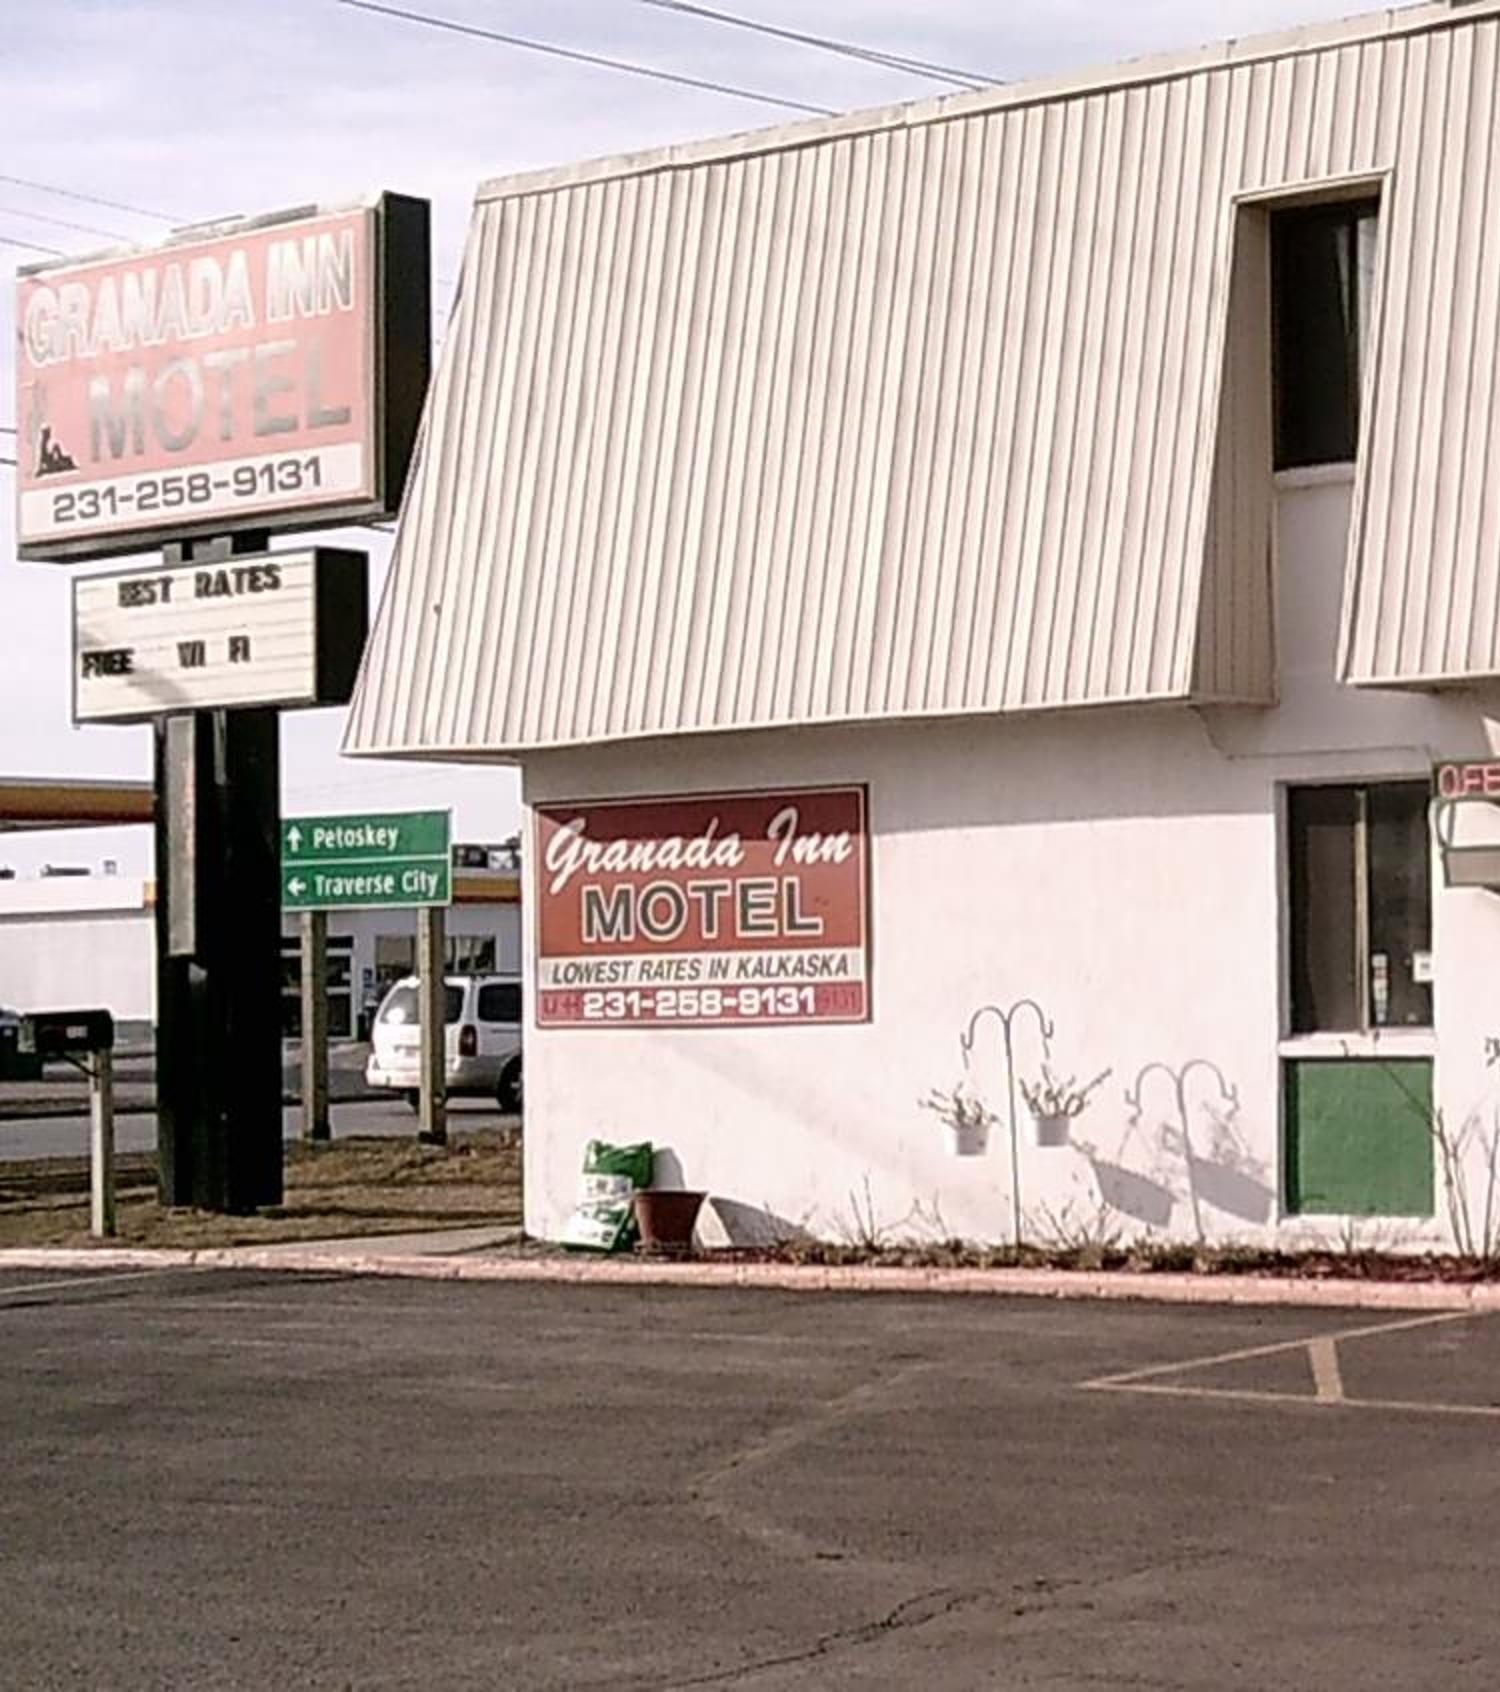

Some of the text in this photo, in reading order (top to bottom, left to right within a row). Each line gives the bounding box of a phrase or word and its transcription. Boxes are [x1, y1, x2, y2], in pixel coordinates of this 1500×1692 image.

[24, 228, 356, 368] GRANADA INN
[87, 338, 353, 465] MOTEL
[52, 455, 324, 524] 231-258-9131
[118, 563, 282, 608] BEST RATES
[81, 647, 136, 679] FREE
[313, 824, 399, 852] Petoskey
[545, 807, 852, 895] Granada Inn
[314, 869, 438, 897] Traverse City
[581, 876, 824, 944] MOTEL
[551, 953, 850, 985] LOWEST RATES IN KALKASKA
